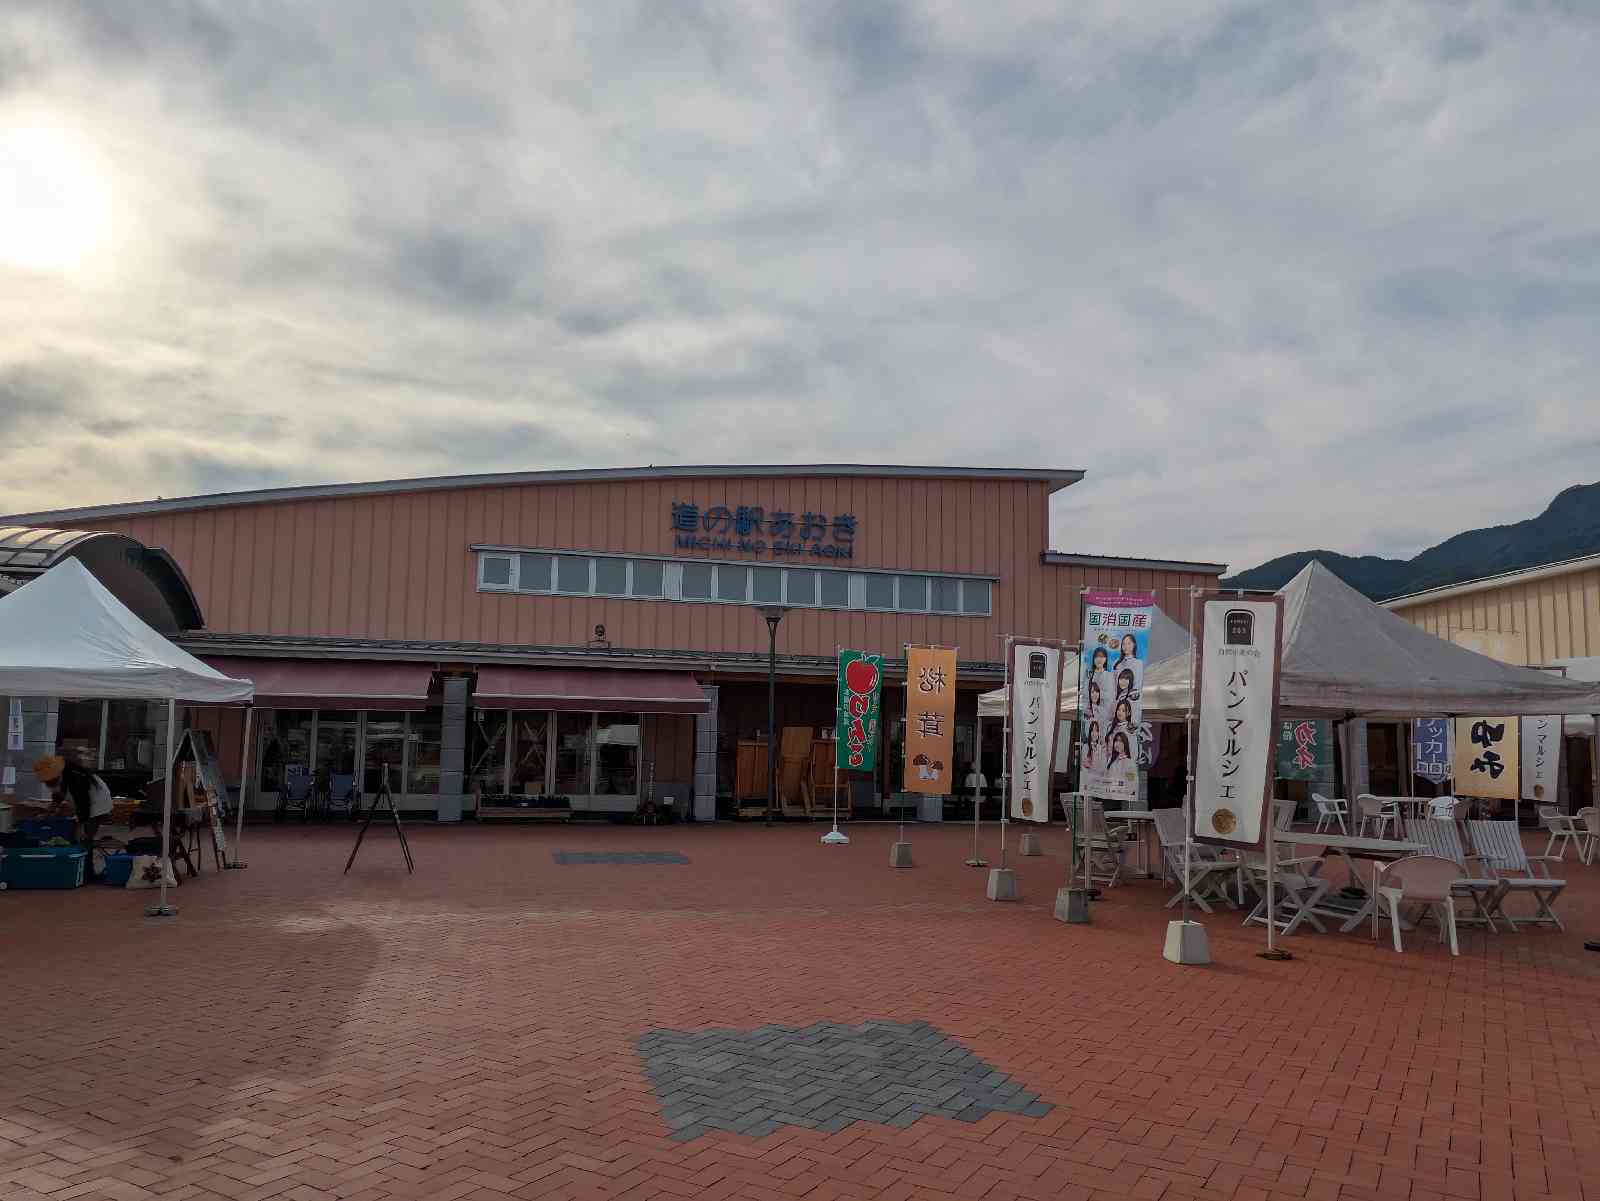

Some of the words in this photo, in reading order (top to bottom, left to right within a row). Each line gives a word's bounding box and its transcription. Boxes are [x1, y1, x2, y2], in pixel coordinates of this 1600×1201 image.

[671, 501, 857, 543] 道の駅あおき
[1088, 611, 1147, 628] 国消国産
[1022, 695, 1041, 792] パンマルシェ
[1219, 669, 1249, 799] パンマルシェ
[1535, 718, 1548, 779] ンマルシェ
